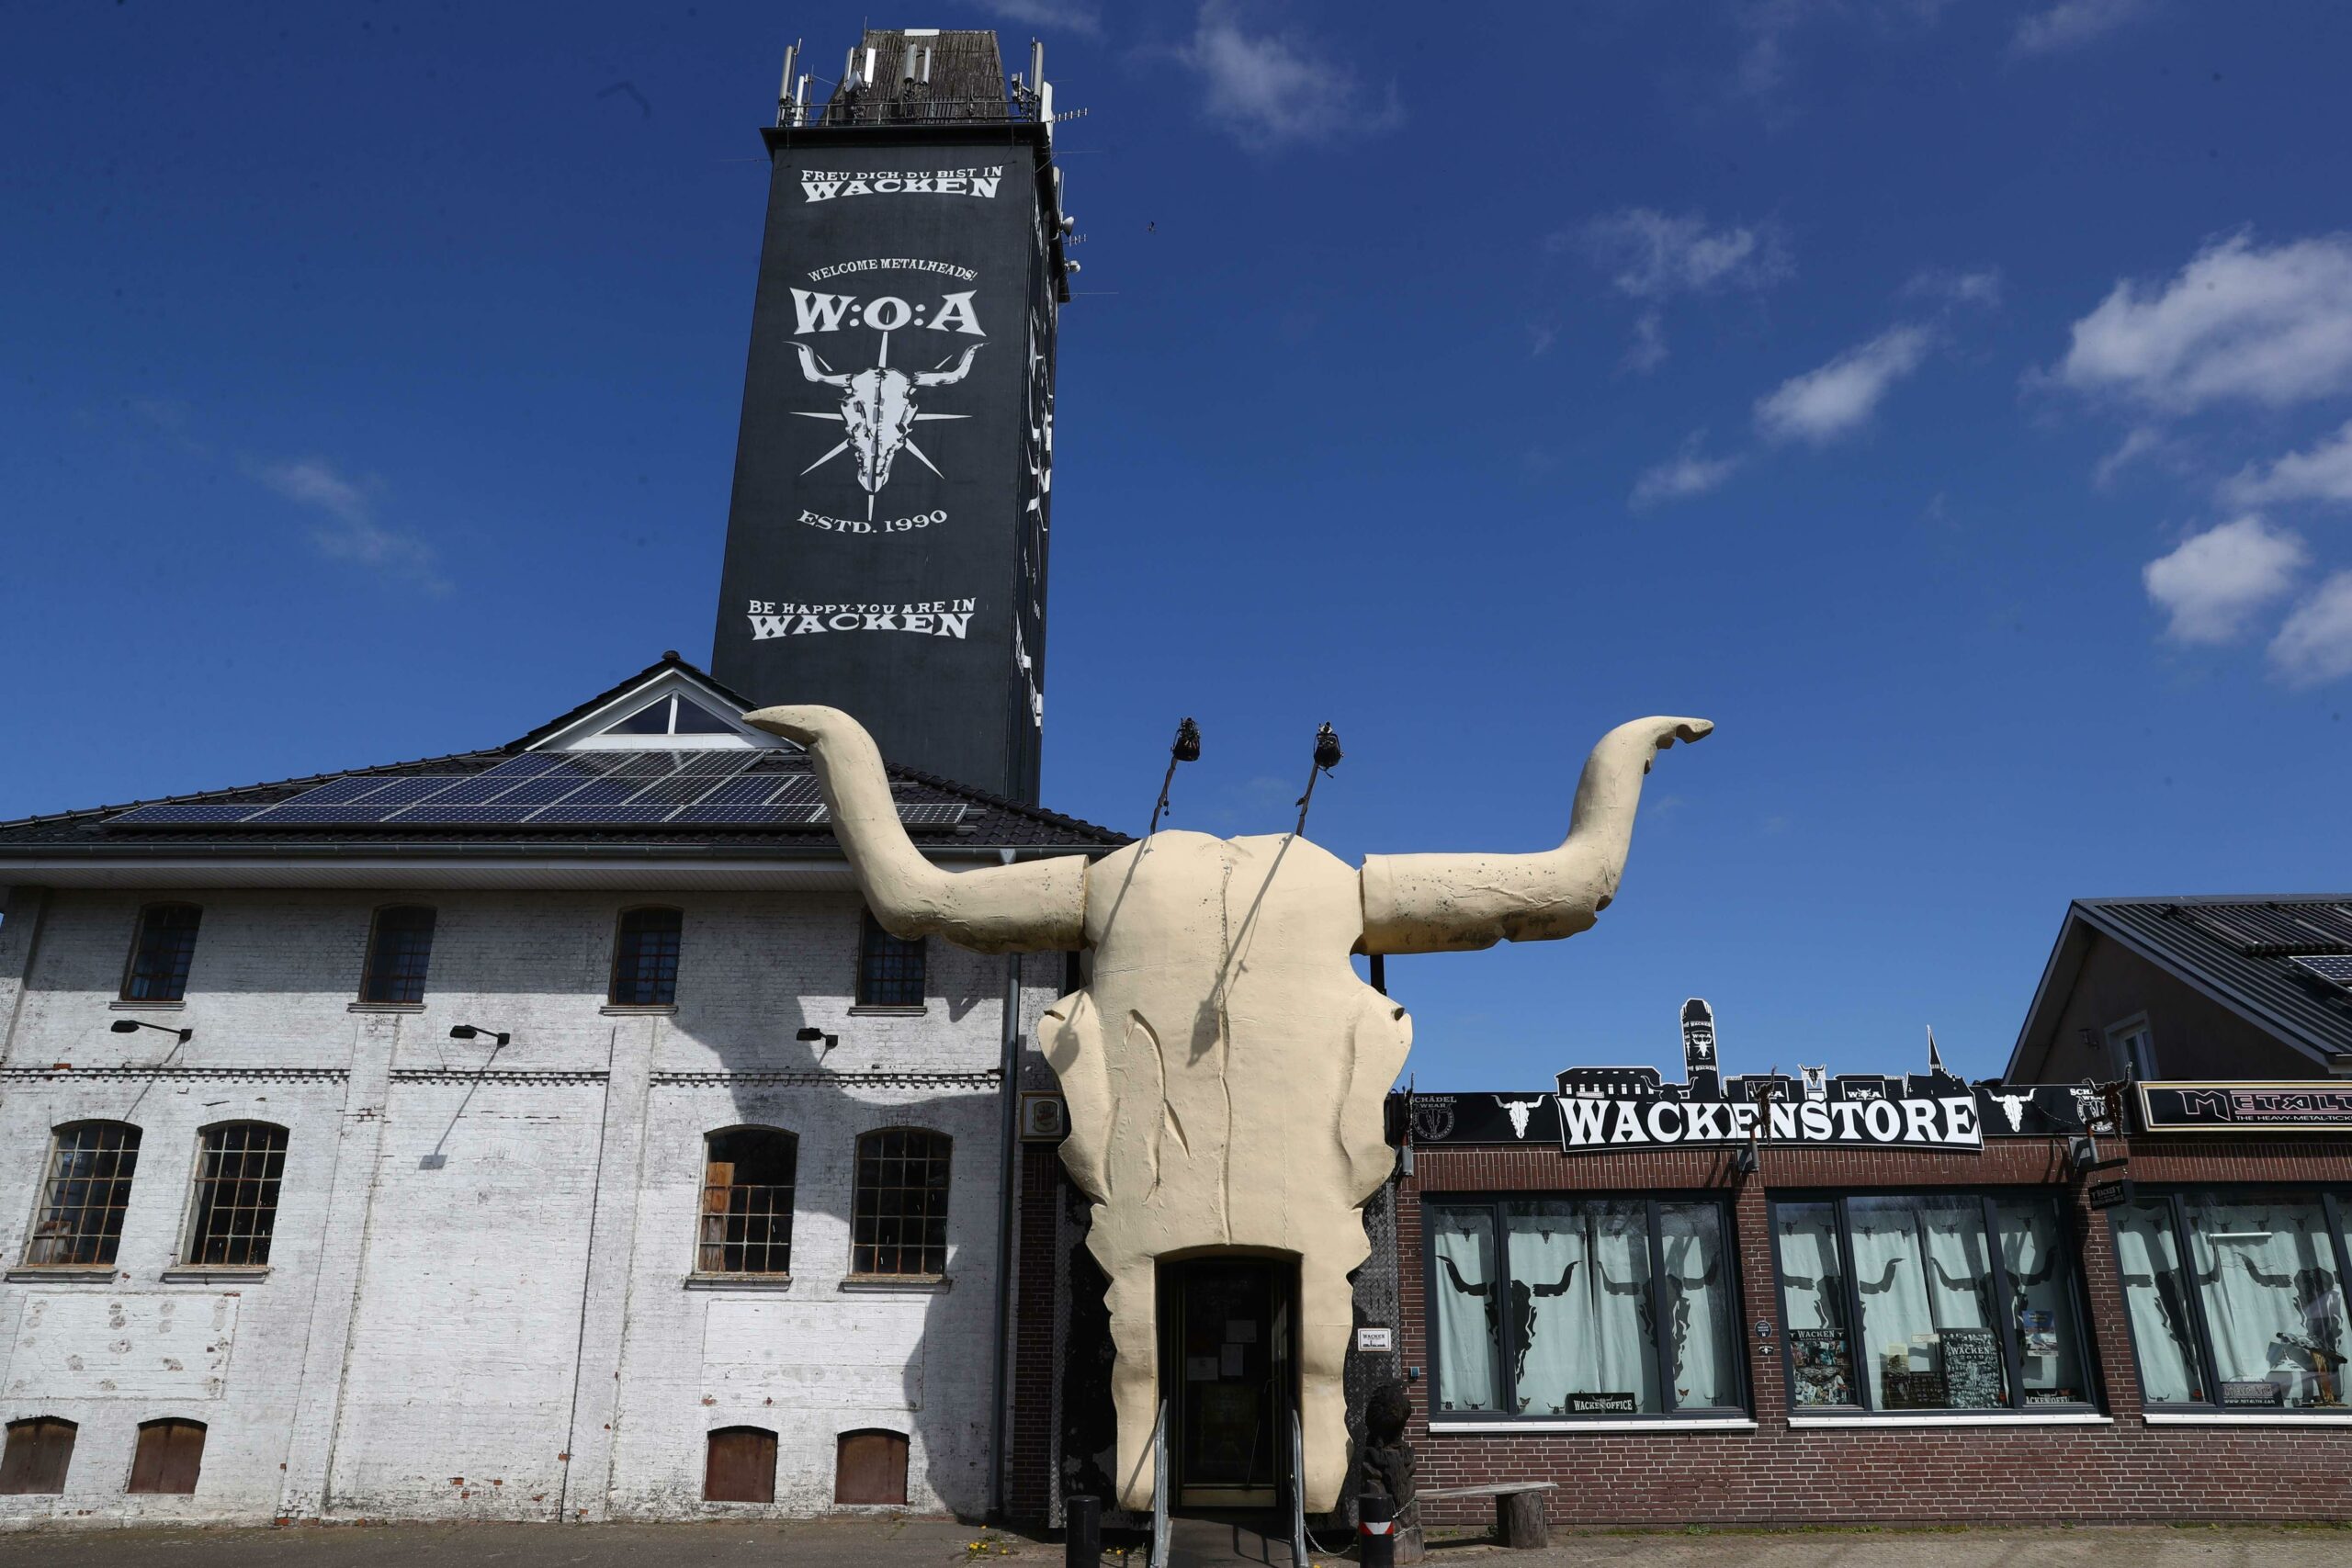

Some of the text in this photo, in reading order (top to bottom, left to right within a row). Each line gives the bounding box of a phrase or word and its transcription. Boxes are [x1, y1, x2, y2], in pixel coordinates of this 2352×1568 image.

[801, 170, 851, 181] FREU
[937, 168, 978, 178] BIST
[983, 165, 1004, 177] IN
[800, 177, 1001, 203] WACKEN
[807, 258, 978, 282] WELCOME METALHEADS!
[789, 287, 988, 337] W:O:A
[797, 509, 947, 534] ESTD. 1990
[747, 600, 775, 615] BE
[901, 601, 945, 614] ARE
[952, 597, 977, 612] IN
[747, 613, 975, 640] WACKEN
[1561, 1096, 1981, 1145] WACKENSTORE
[1797, 1329, 1835, 1338] WACKEN
[1950, 1346, 1990, 1355] WACKEN
[1574, 1399, 1633, 1411] WACKEN OFFICE
